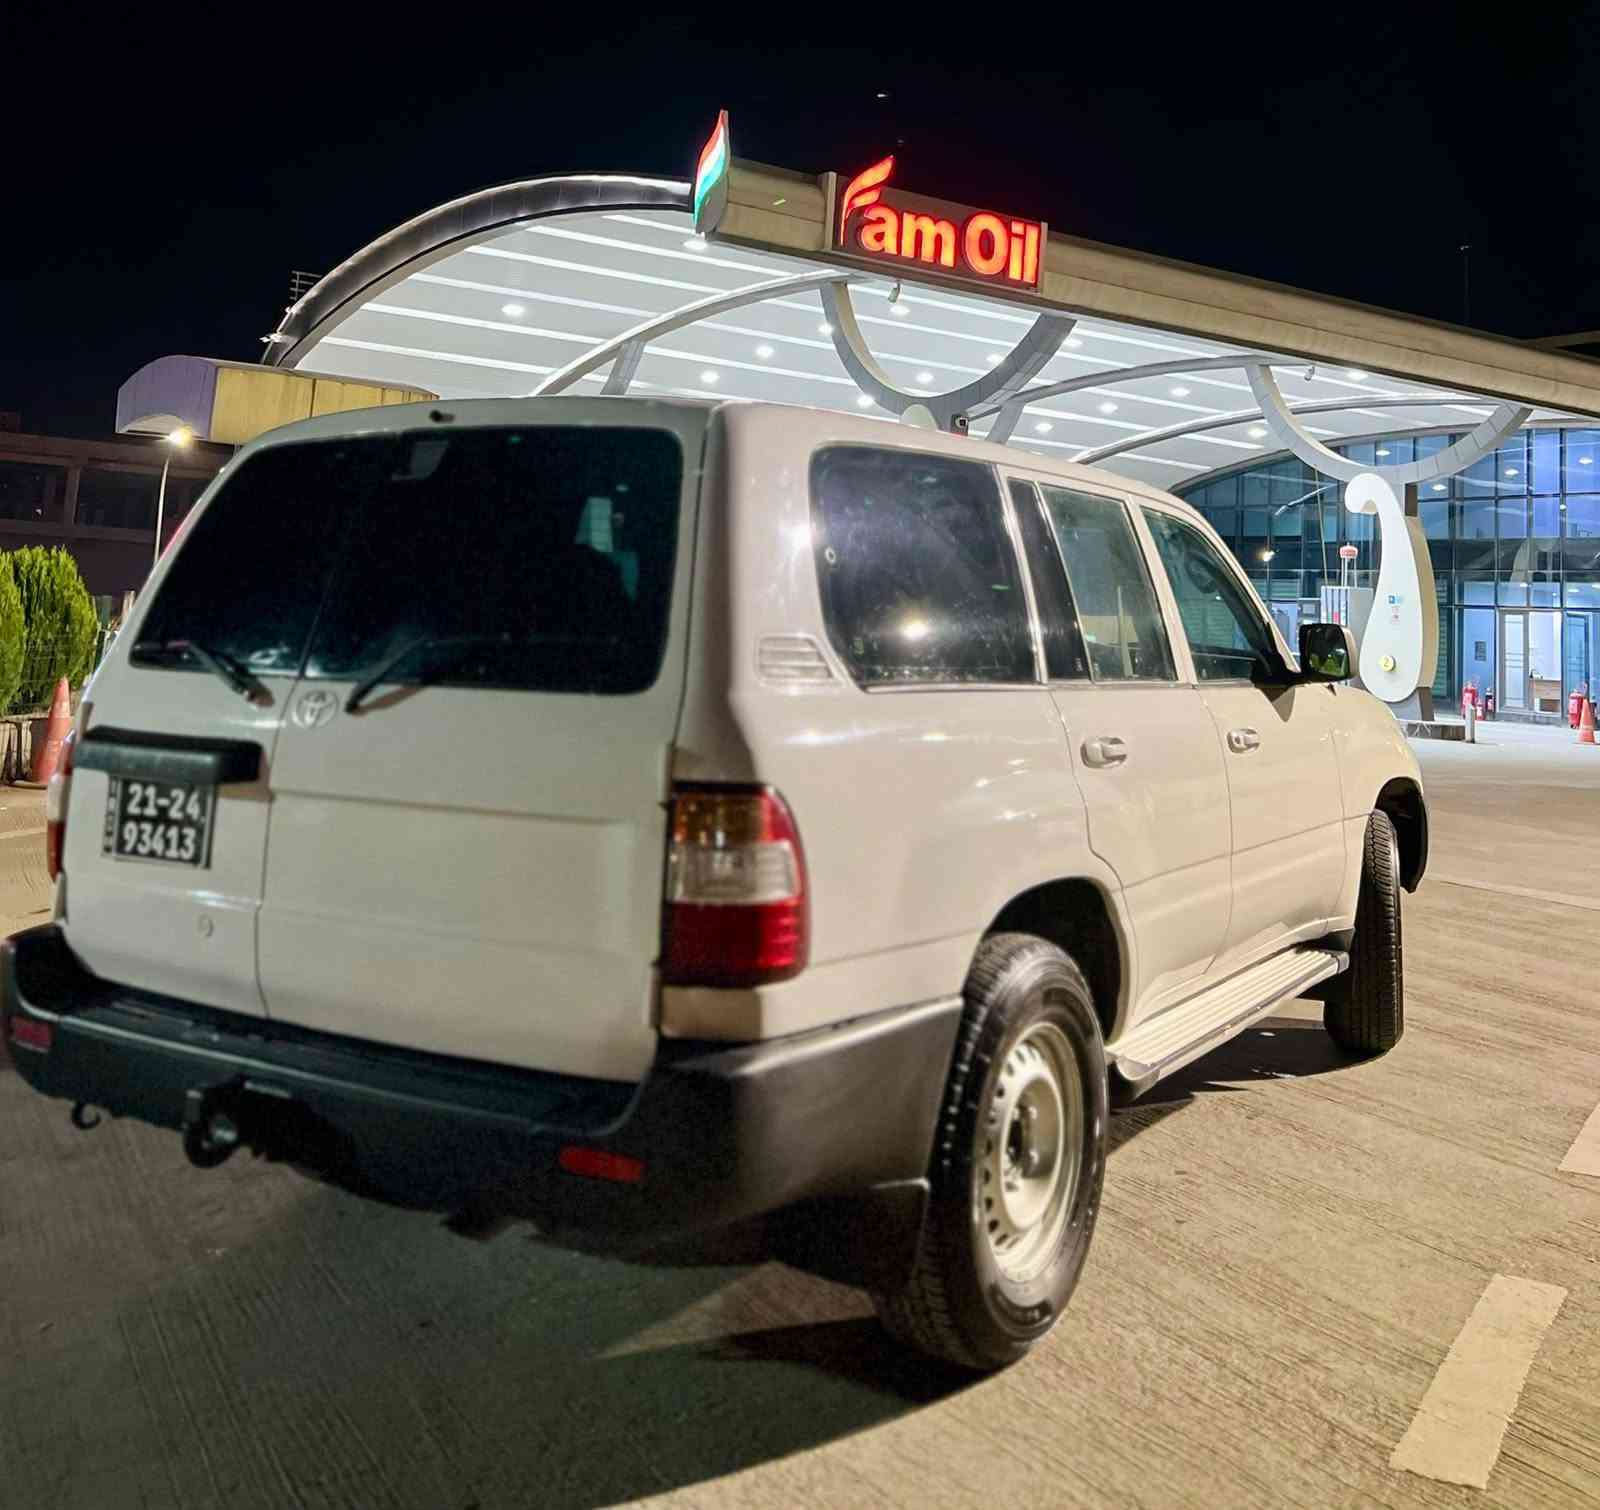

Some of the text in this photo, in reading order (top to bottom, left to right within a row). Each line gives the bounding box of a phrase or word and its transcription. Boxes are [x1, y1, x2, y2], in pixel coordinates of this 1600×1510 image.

[840, 154, 1040, 284] Fam Oil
[126, 782, 201, 822] 21-24
[122, 820, 197, 861] 93413
